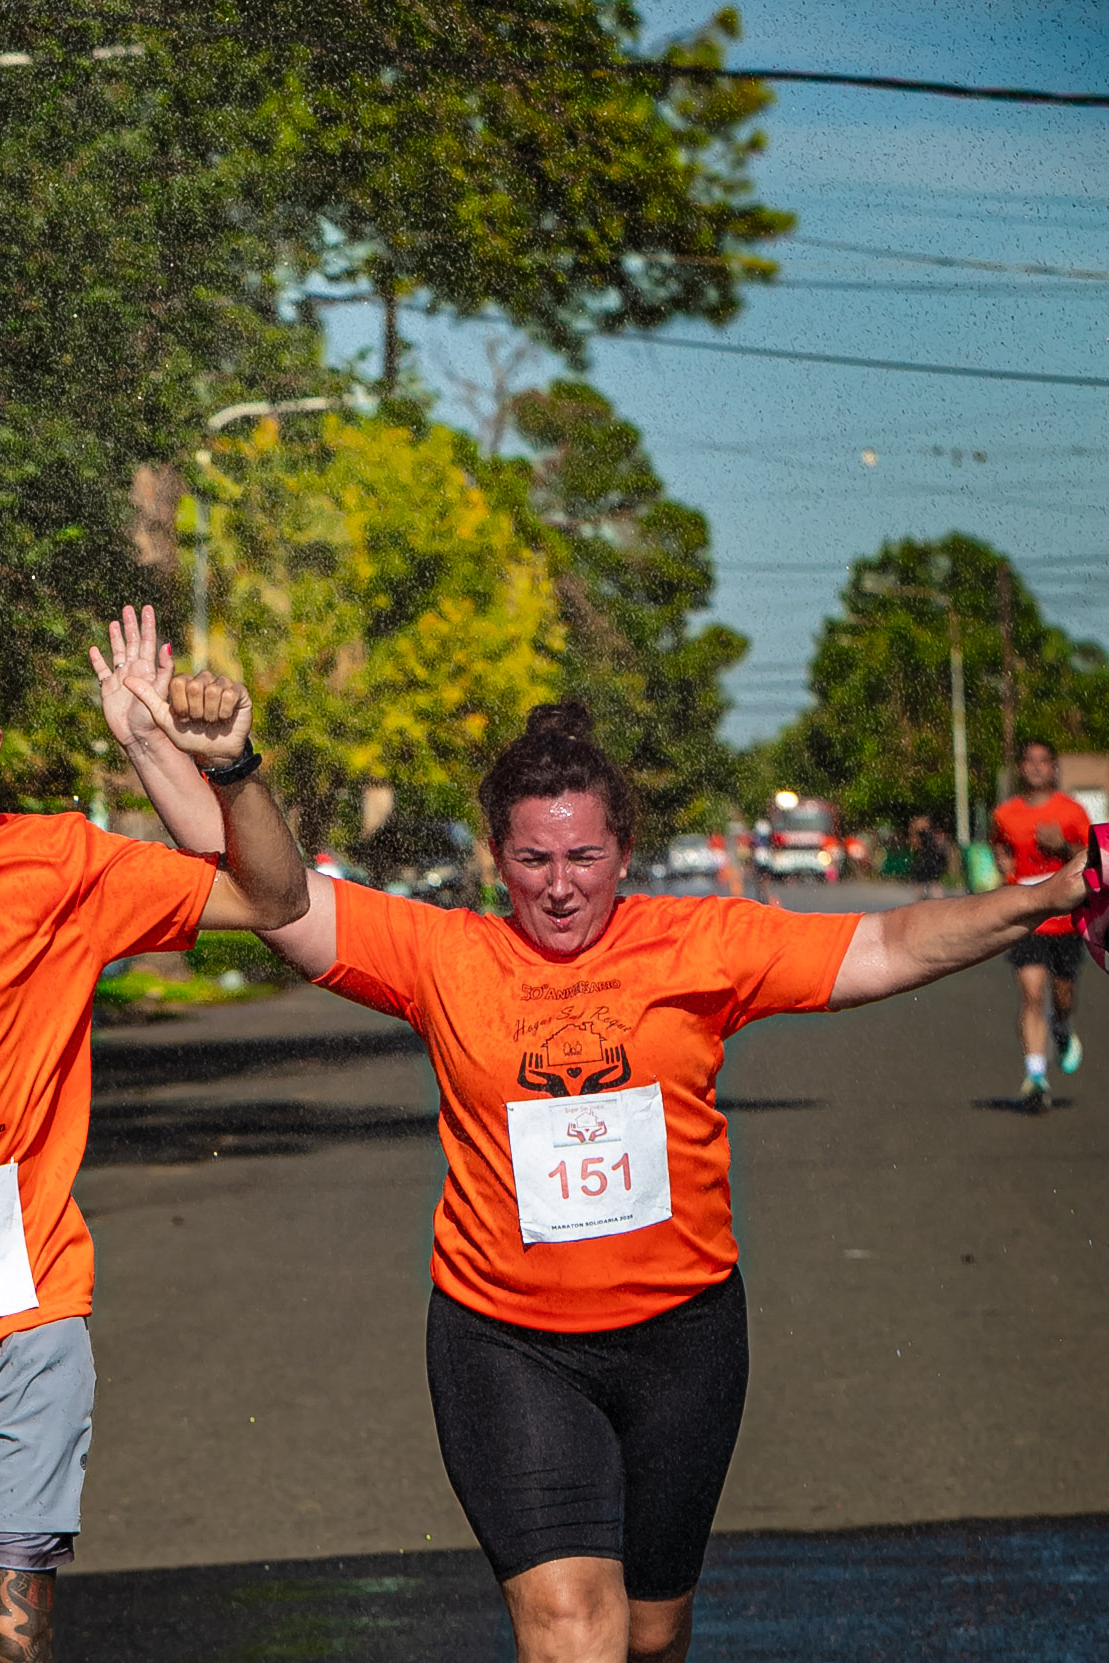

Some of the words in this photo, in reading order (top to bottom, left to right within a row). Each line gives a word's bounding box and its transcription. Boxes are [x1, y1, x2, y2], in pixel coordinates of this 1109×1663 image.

[548, 1153, 632, 1200] 151
[551, 1222, 584, 1231] MARATON
[585, 1217, 619, 1227] SOLIDARIA
